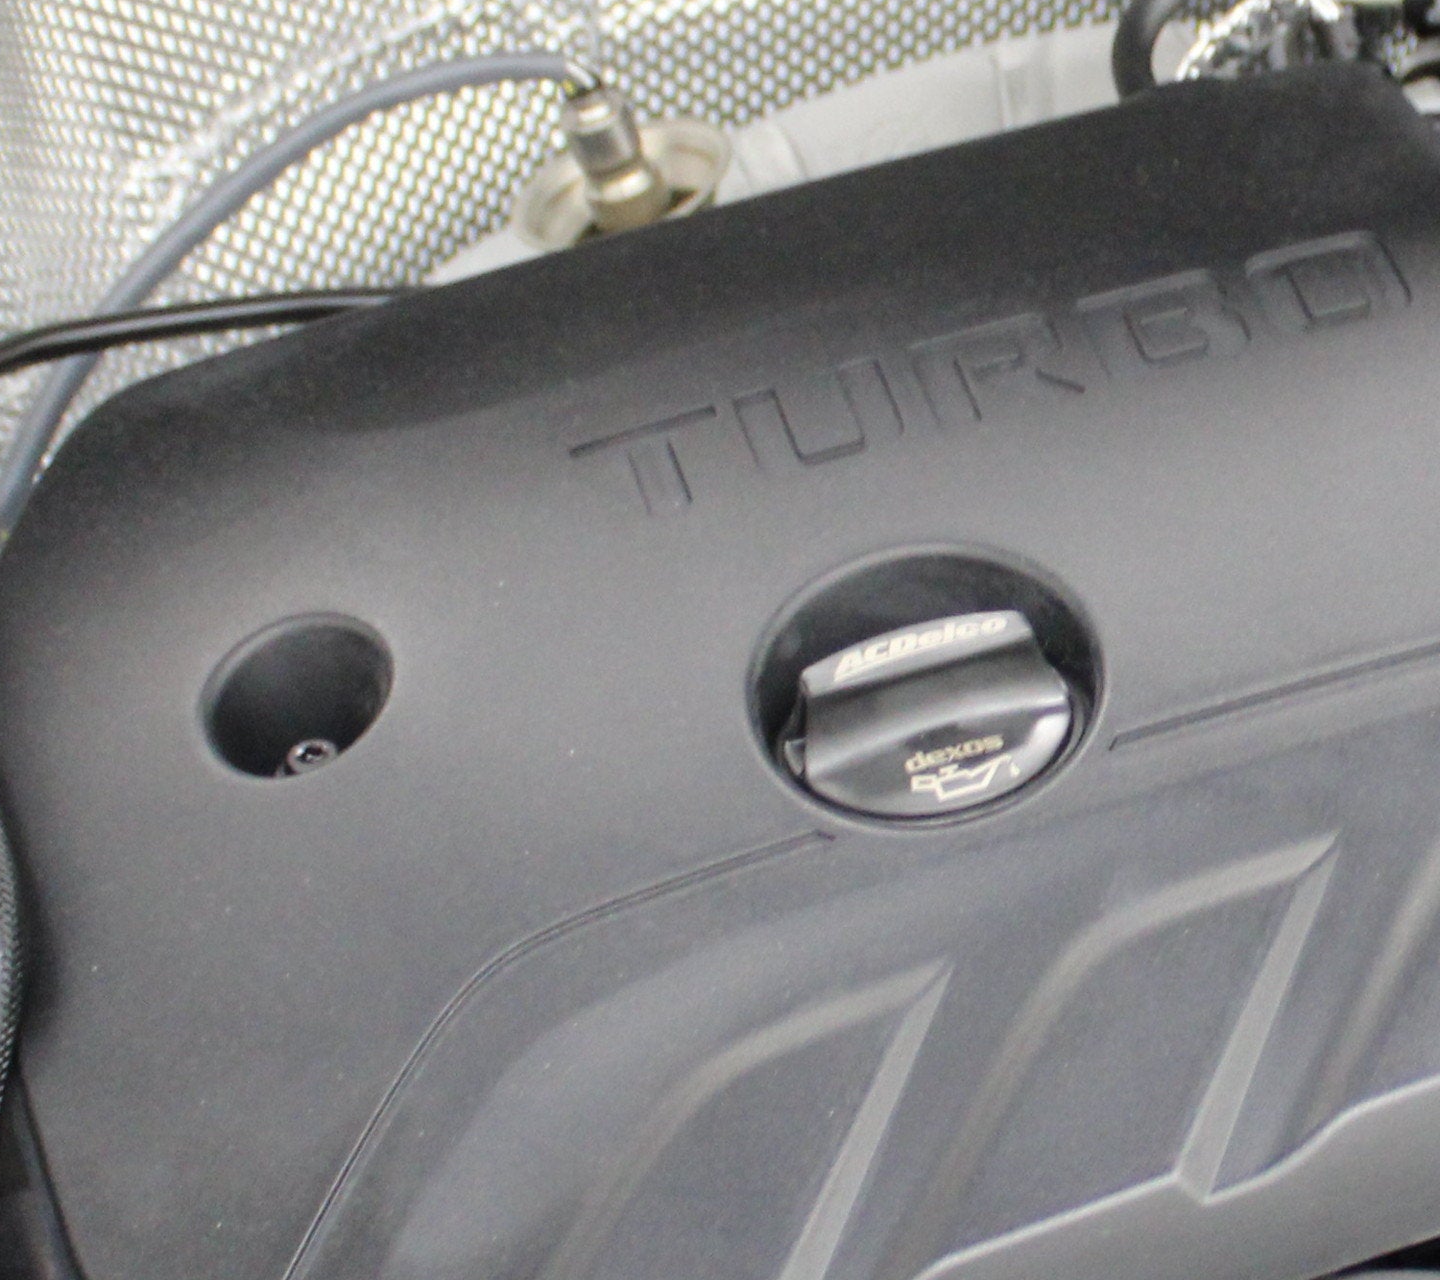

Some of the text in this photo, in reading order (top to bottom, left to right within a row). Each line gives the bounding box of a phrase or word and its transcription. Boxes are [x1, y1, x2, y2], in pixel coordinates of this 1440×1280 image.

[568, 230, 1412, 516] TURBO
[833, 617, 1008, 682] ACDelco
[904, 733, 1004, 774] dexos
